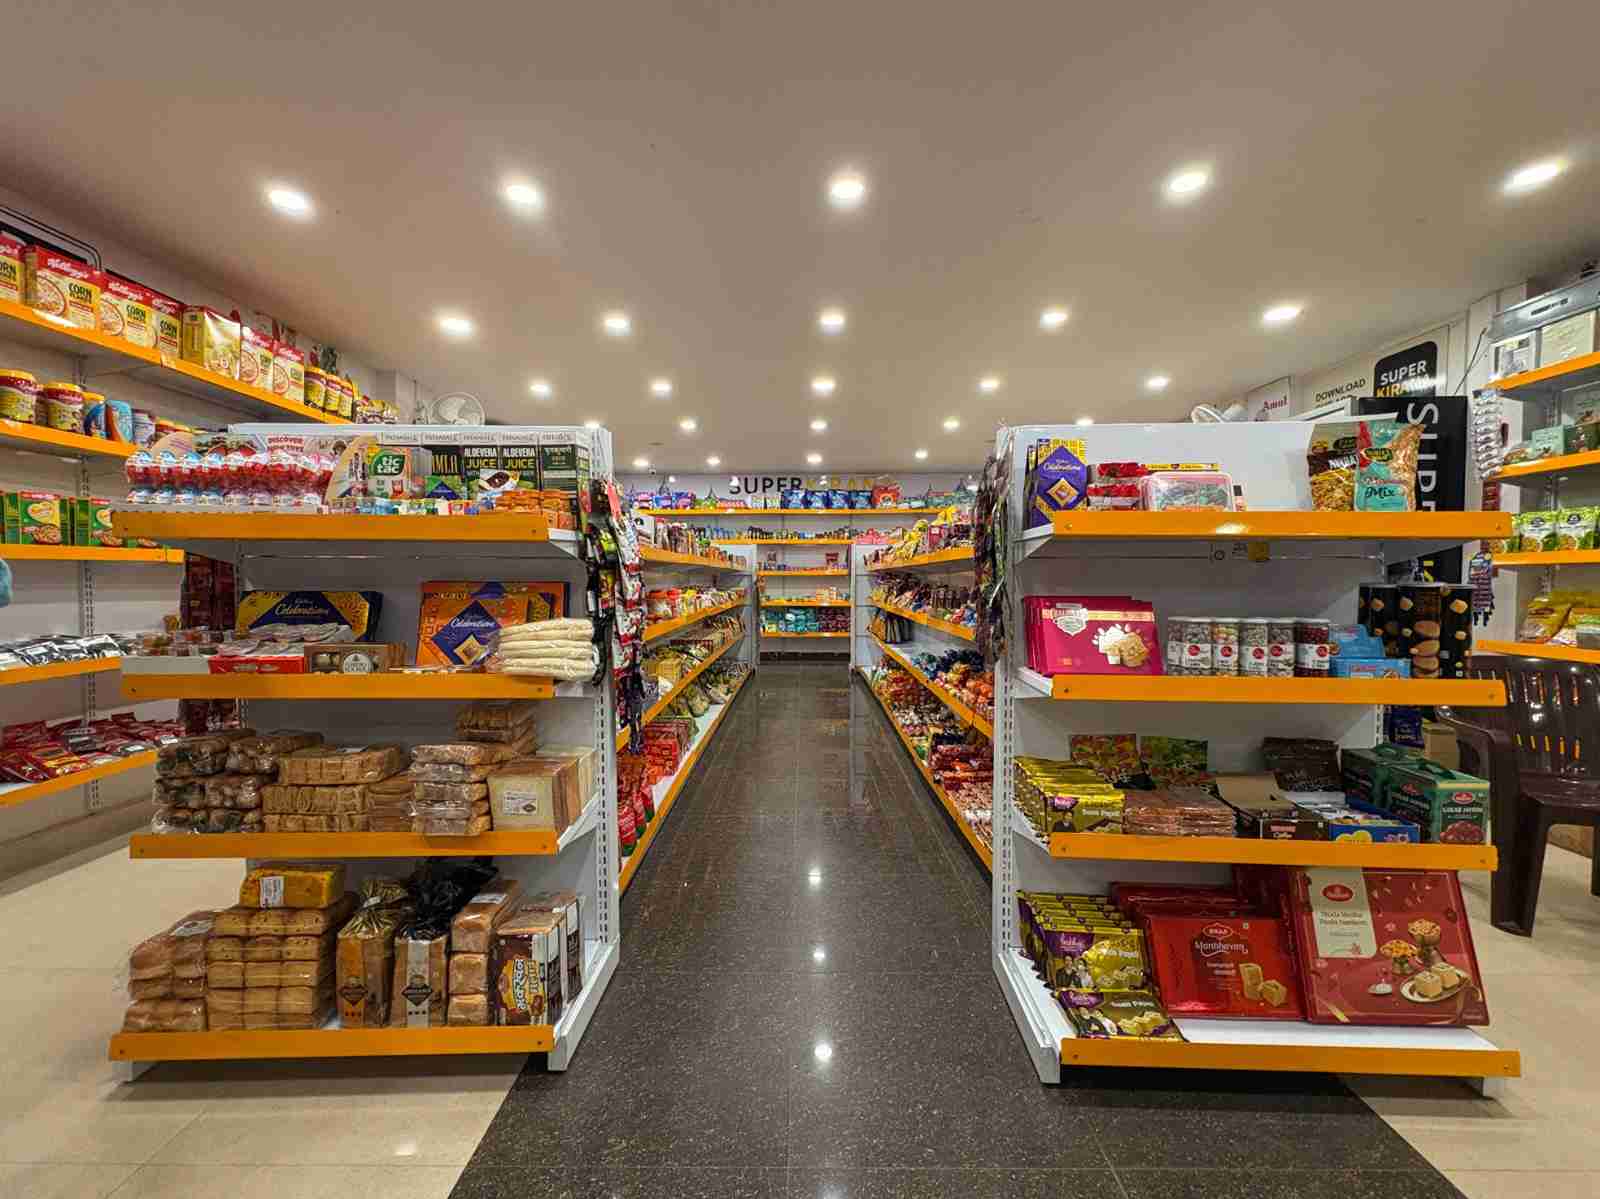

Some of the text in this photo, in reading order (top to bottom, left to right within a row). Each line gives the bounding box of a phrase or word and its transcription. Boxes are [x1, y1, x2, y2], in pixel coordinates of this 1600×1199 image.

[69, 282, 93, 299] CORN
[1380, 360, 1427, 386] SUPER
[1315, 378, 1366, 402] DOWNLOAD
[464, 448, 497, 457] ALOEVERA
[503, 448, 536, 457] ALOEVERA
[382, 456, 399, 465] tic
[465, 458, 497, 468] JUICE
[505, 458, 536, 468] JUICE
[377, 464, 399, 474] tac
[729, 477, 803, 495] SUPER
